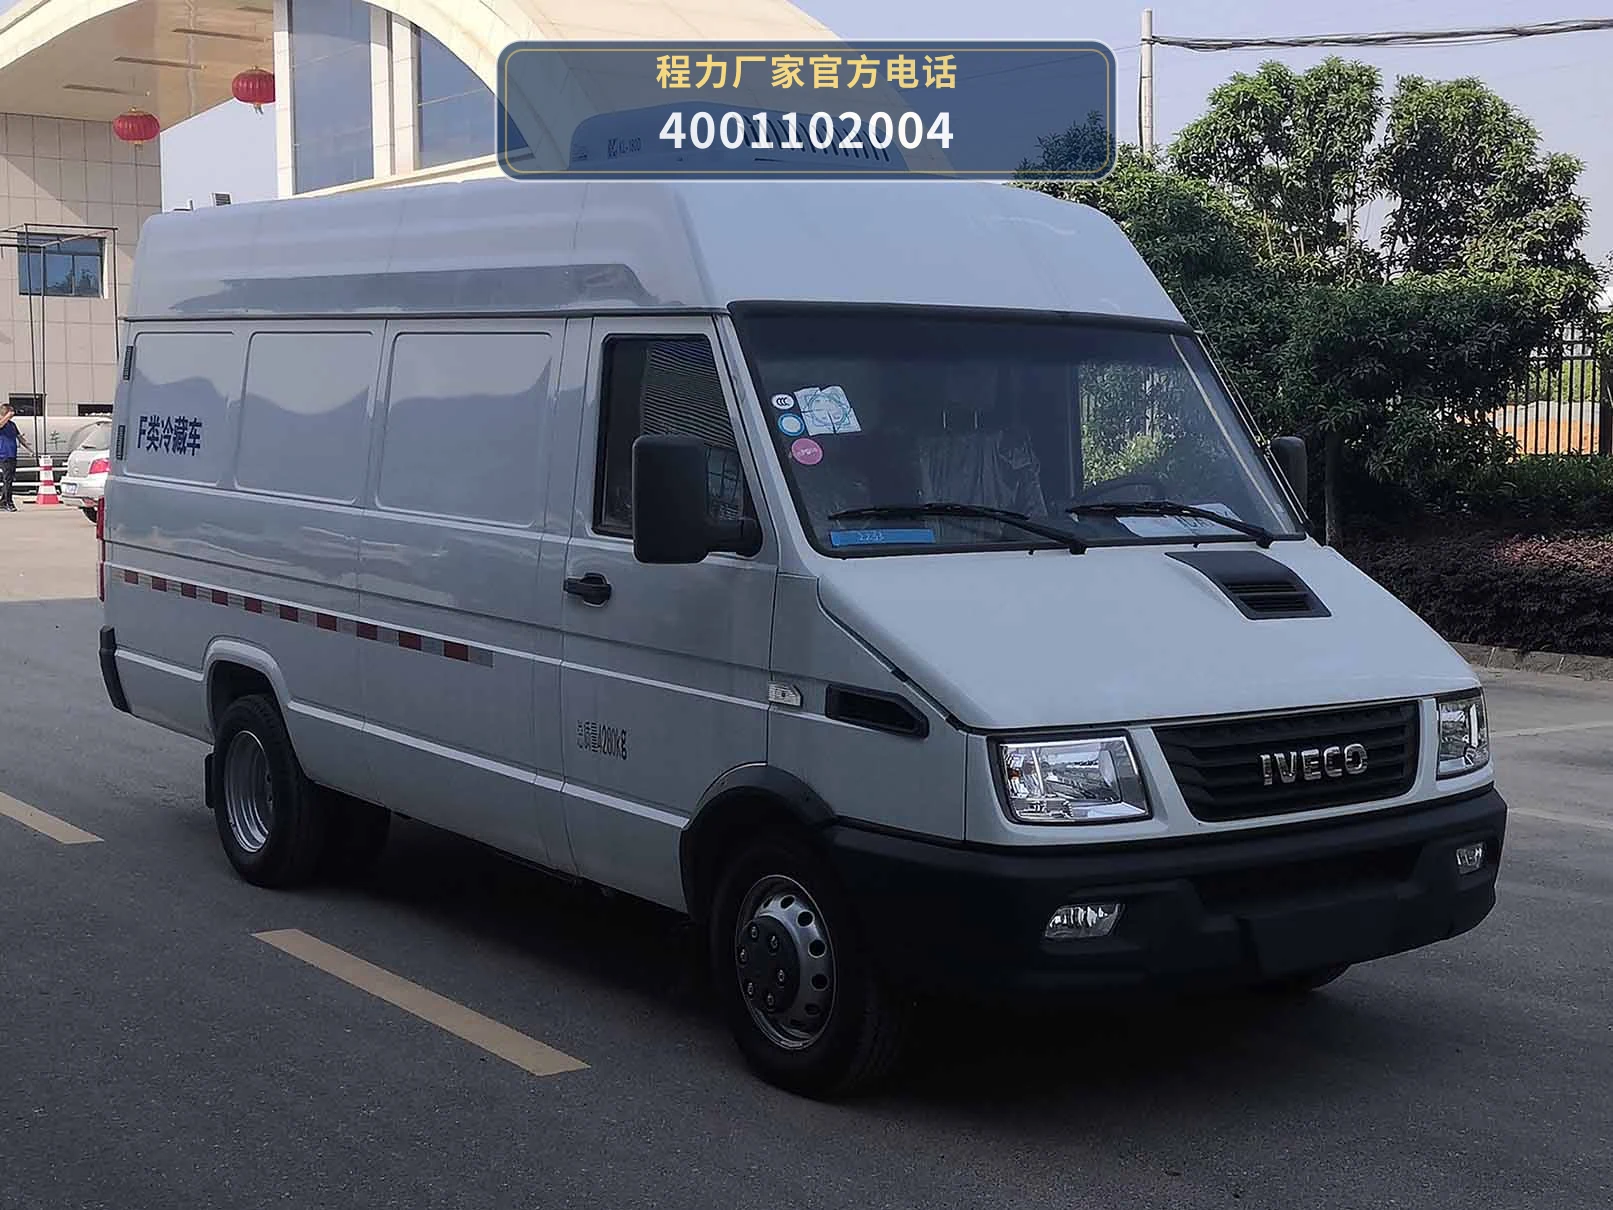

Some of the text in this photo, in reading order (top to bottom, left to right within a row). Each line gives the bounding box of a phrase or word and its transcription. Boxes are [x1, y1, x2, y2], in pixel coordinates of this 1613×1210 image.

[138, 415, 202, 456] F类冷藏车
[1260, 743, 1368, 786] IVECO
